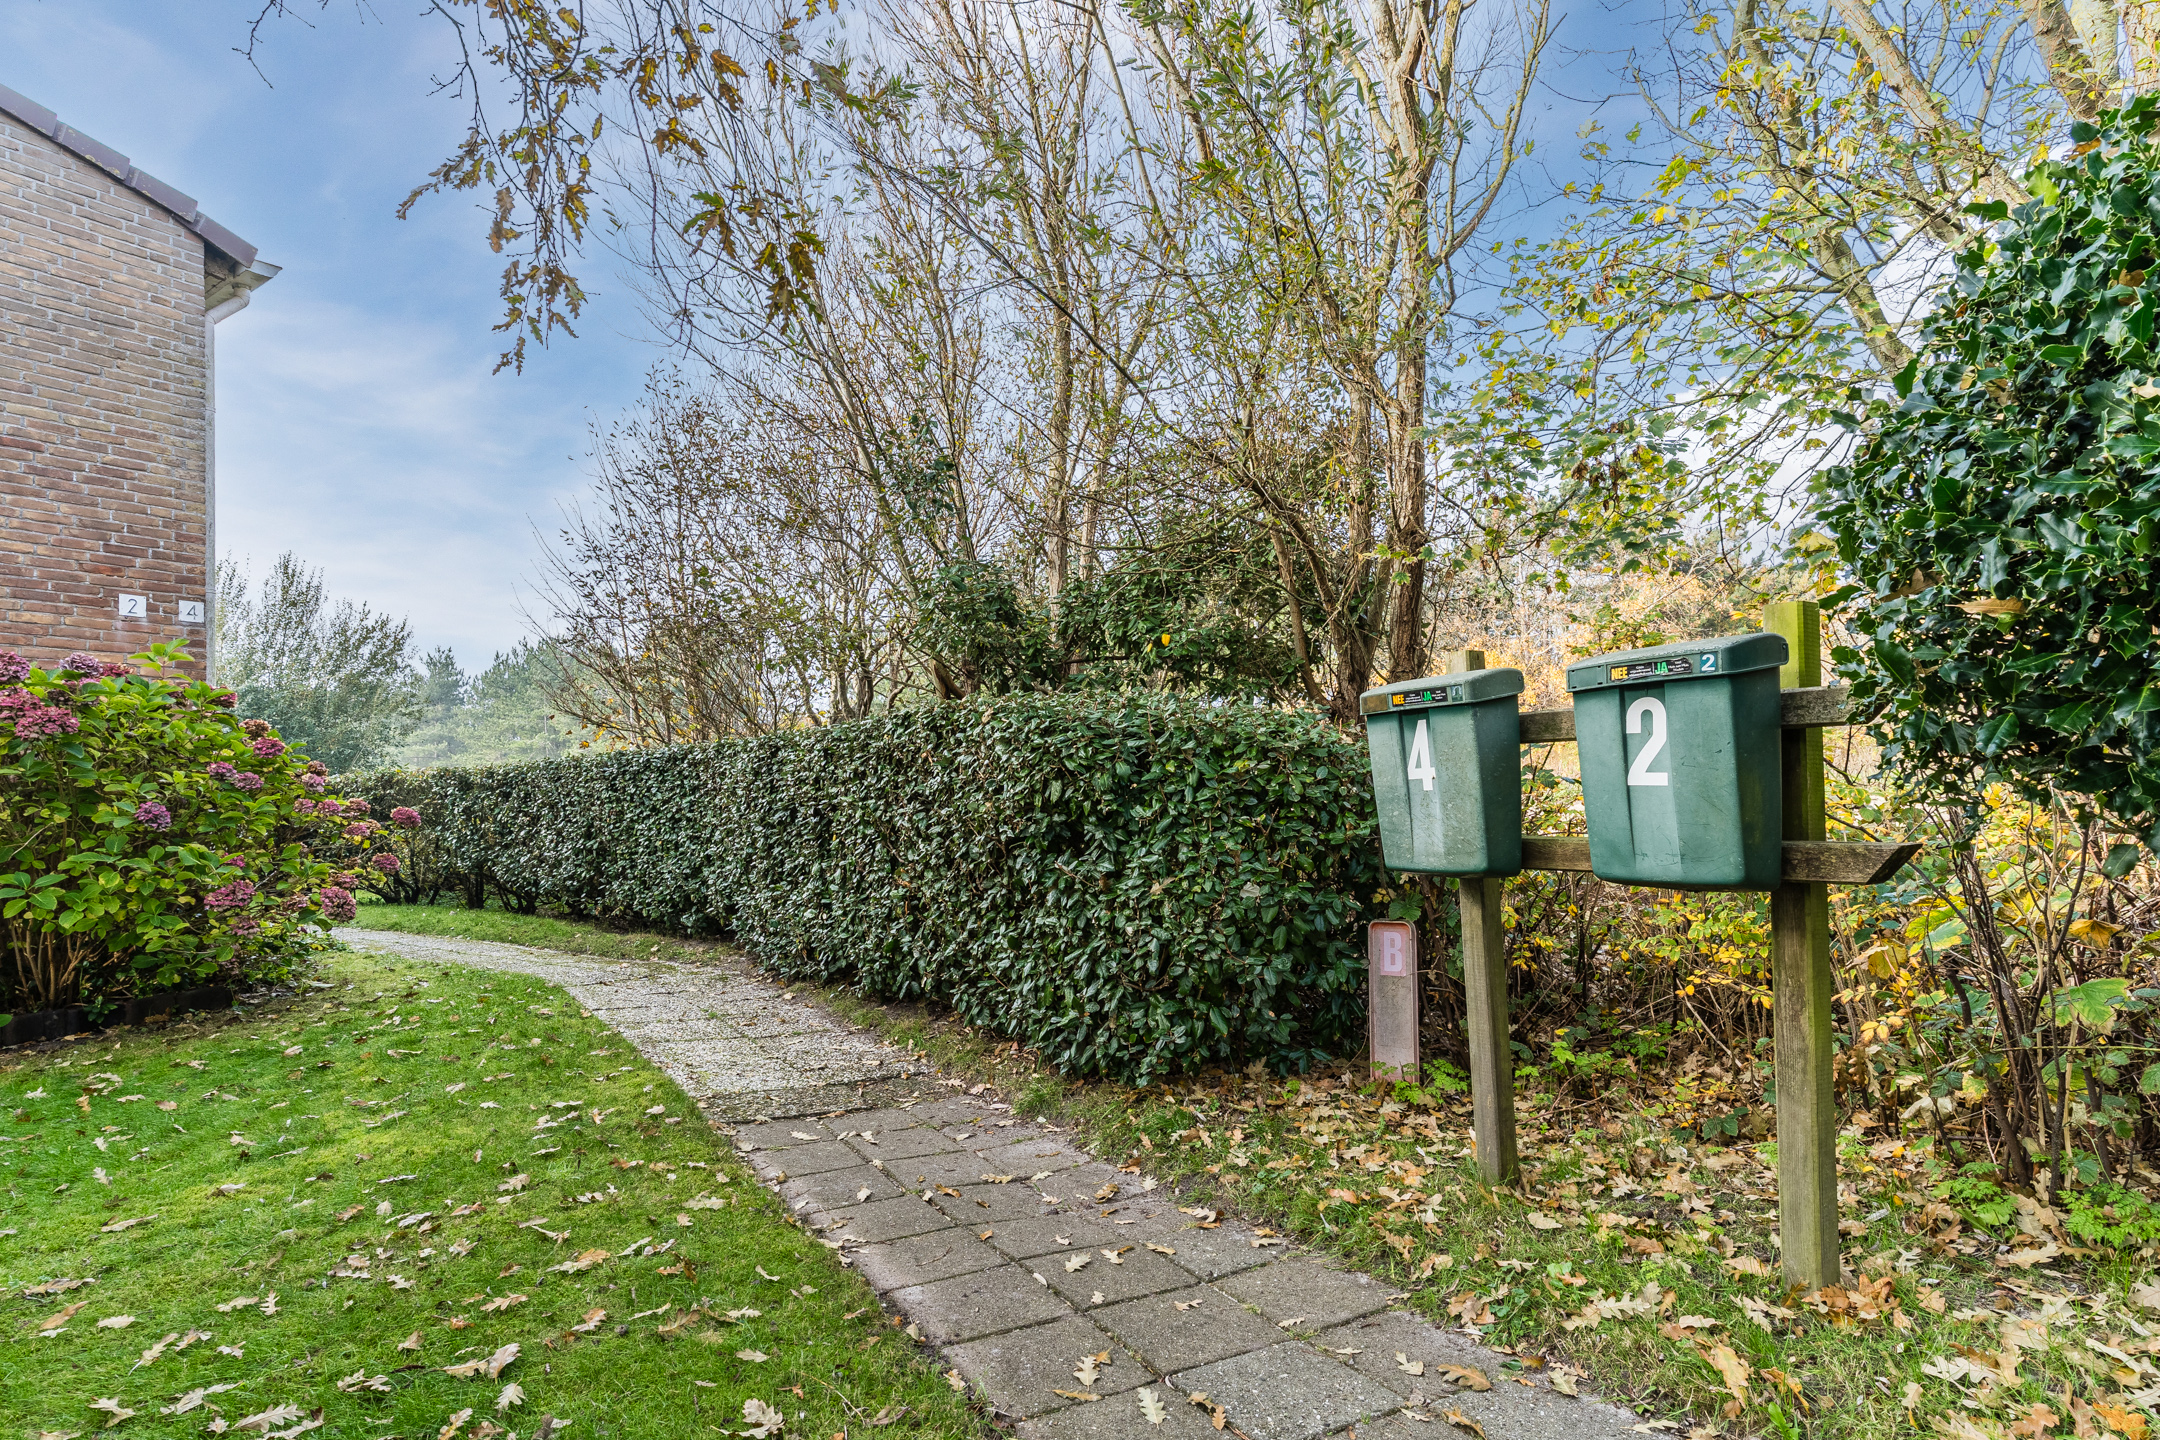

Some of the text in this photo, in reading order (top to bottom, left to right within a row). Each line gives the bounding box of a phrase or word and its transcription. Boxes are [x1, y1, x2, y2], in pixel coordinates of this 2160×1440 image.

[128, 598, 138, 615] 2
[186, 604, 198, 620] 4
[1611, 666, 1628, 681] NEE
[1655, 661, 1669, 675] JA
[1701, 653, 1716, 672] 2
[1392, 694, 1405, 705] NEE
[1423, 691, 1433, 702] JA
[1625, 696, 1669, 786] 2
[1407, 719, 1436, 791] 4
[1383, 931, 1403, 972] B
